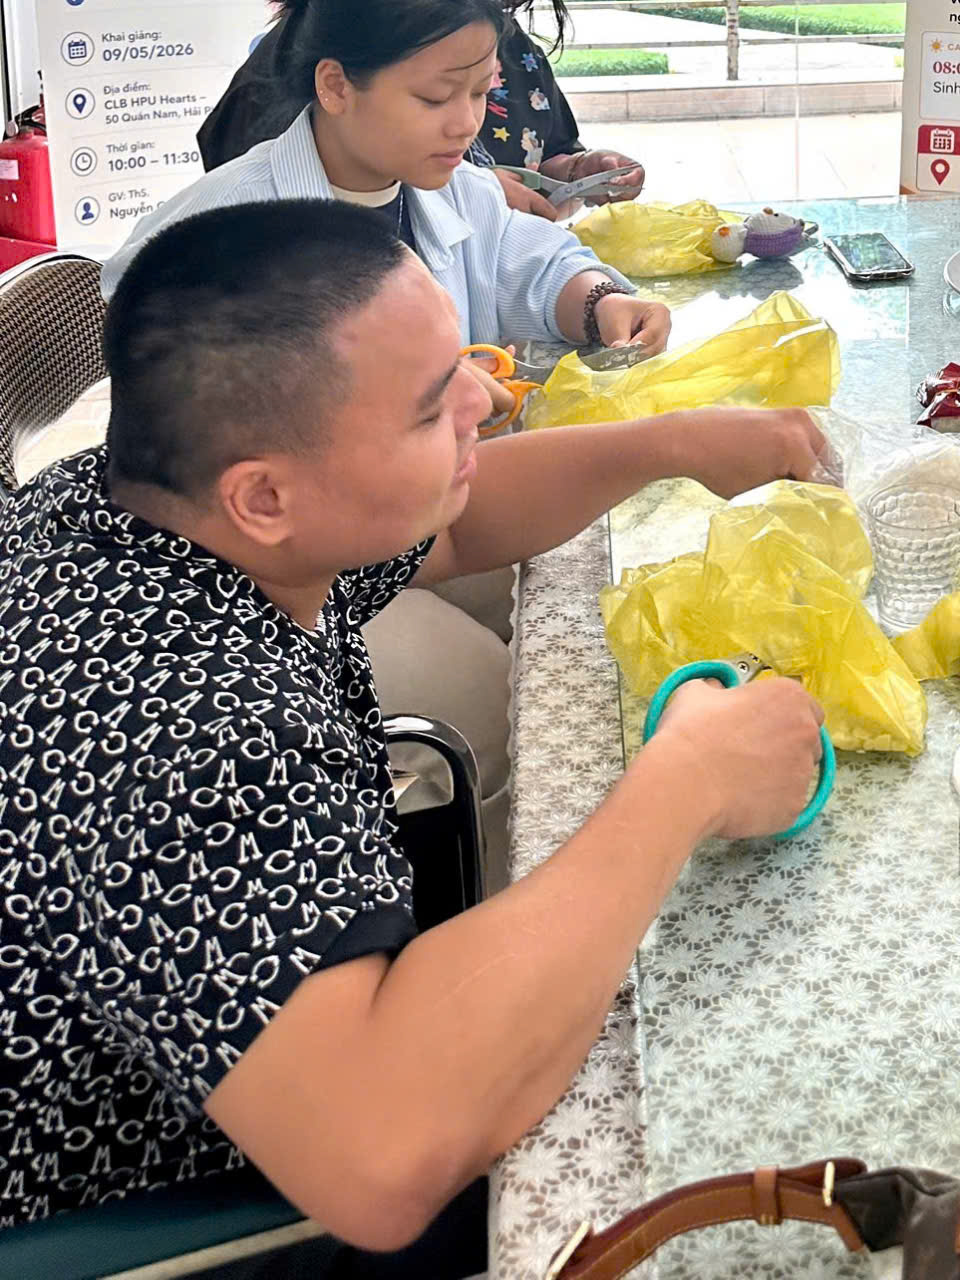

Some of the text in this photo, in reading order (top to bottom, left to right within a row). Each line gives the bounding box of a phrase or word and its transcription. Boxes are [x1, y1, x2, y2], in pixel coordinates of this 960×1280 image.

[101, 32, 125, 42] Khai
[102, 43, 194, 62] 09/05/2026
[947, 43, 960, 51] CA
[104, 94, 197, 110] CLB HPU Hearts
[105, 114, 119, 124] 50
[121, 111, 150, 122] Quán
[108, 151, 200, 172] 10:00 11:30
